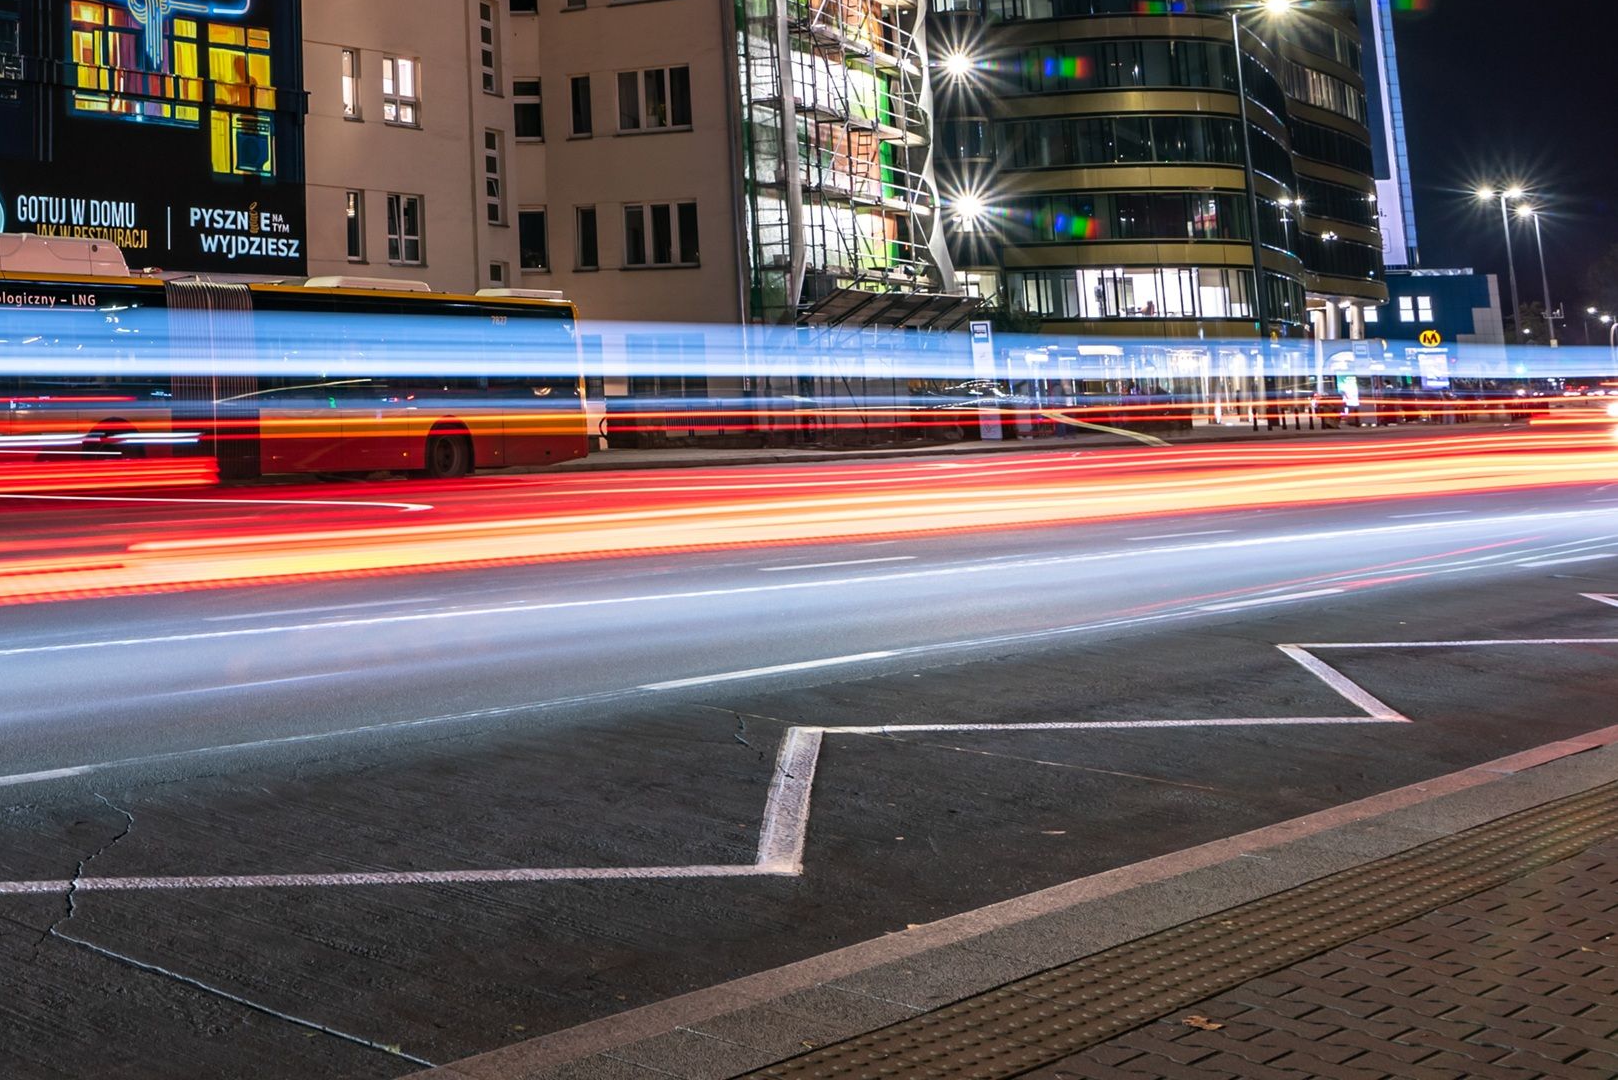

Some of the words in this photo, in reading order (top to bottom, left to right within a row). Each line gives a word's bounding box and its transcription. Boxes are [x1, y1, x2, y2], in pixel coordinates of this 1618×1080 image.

[17, 194, 67, 224] GOTUJ
[70, 198, 86, 226] W
[90, 199, 135, 228] DOMU
[271, 213, 284, 224] NA
[271, 223, 290, 234] TYM
[200, 233, 300, 259] WYJDZIESZ
[71, 293, 97, 307] LNG
